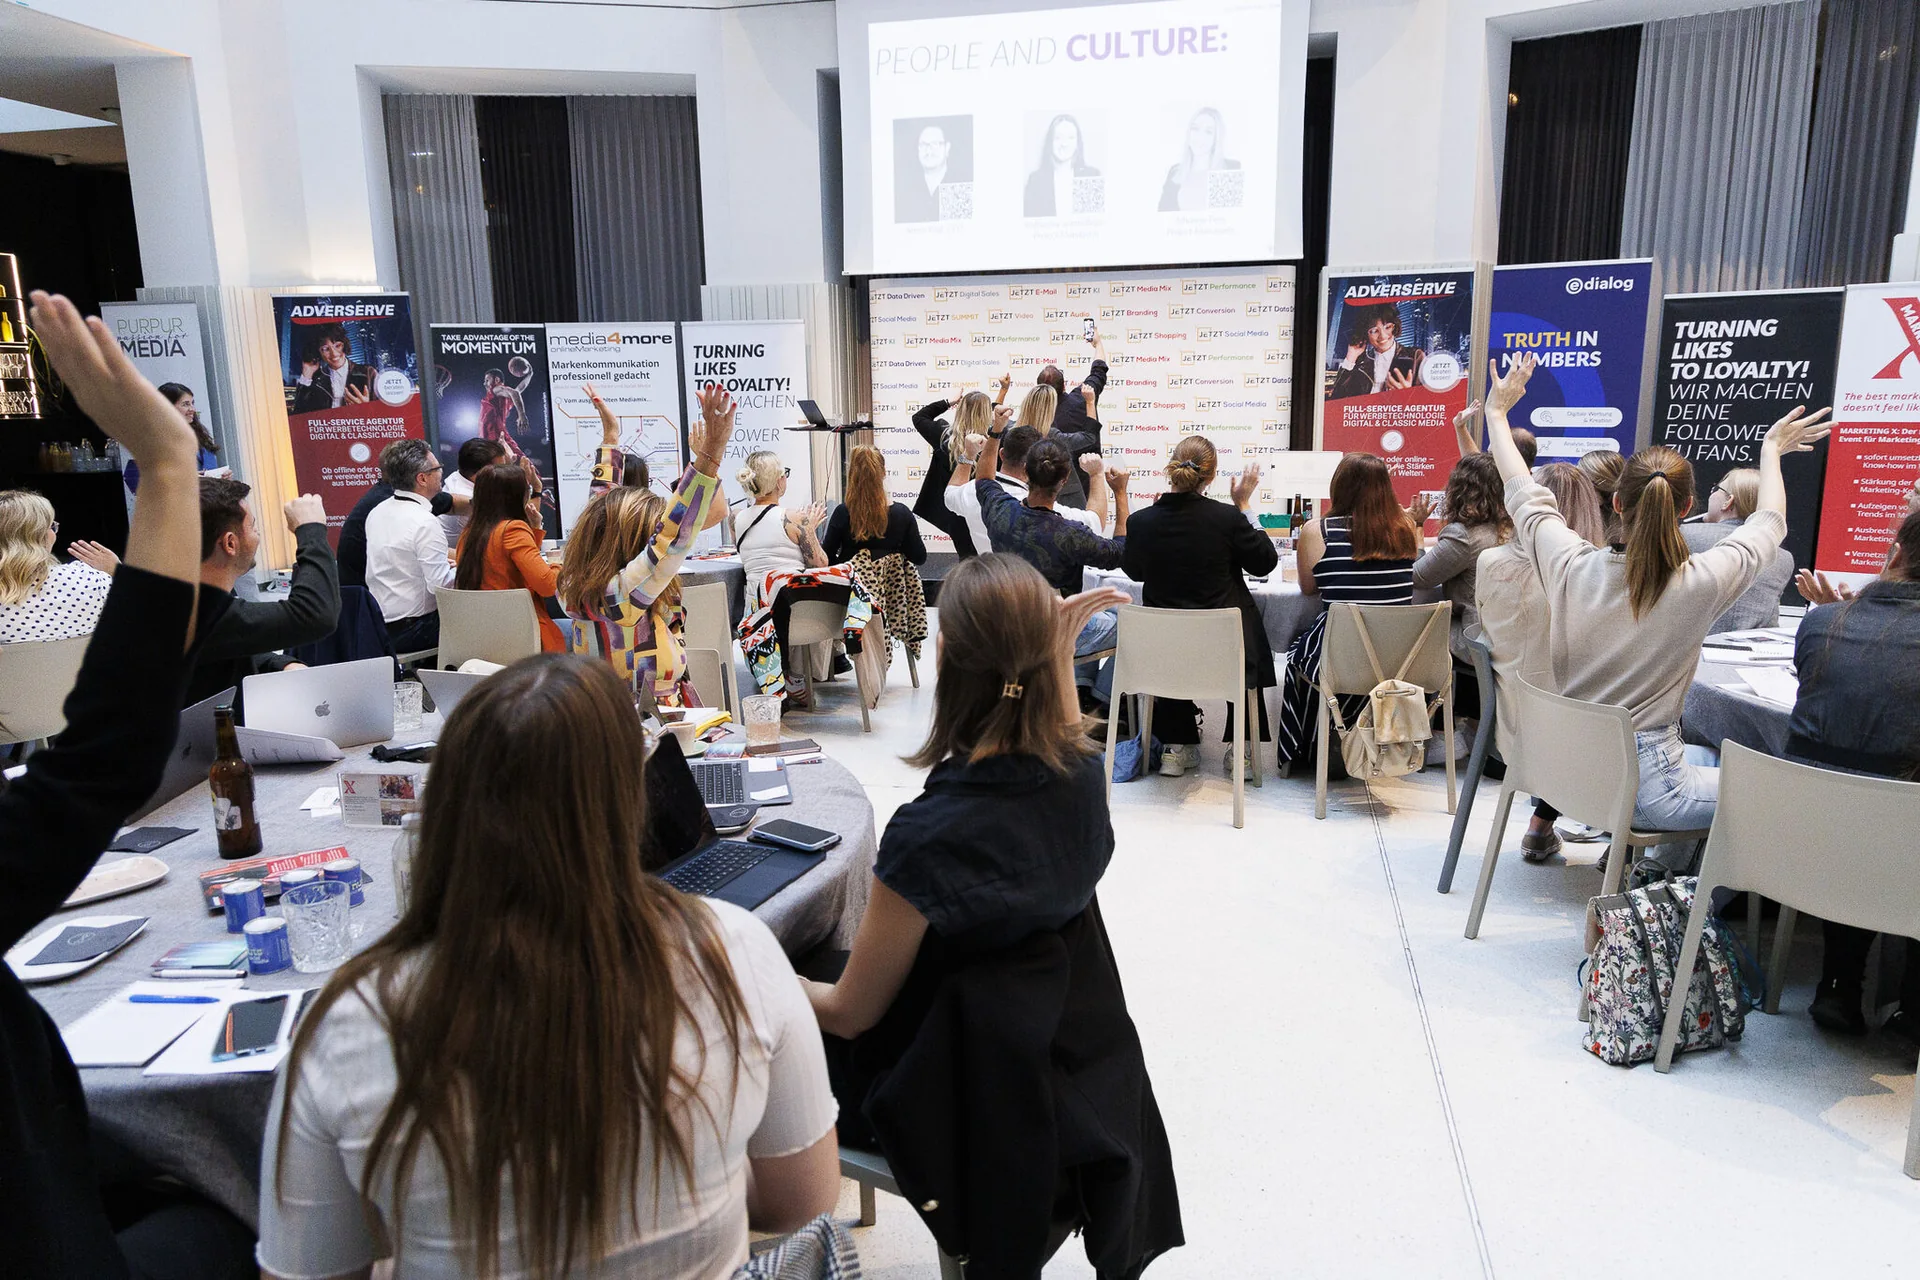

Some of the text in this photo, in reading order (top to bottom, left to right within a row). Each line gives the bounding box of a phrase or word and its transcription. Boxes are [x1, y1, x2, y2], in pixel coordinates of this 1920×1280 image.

[876, 24, 1228, 76] PEOPLE AND CULTURE:
[1344, 281, 1457, 298] ADVERSERVE
[960, 291, 980, 299] Digital
[290, 304, 396, 318] ADVERSERVE
[1126, 309, 1158, 318] Branding
[117, 317, 183, 334] PURPUR
[1674, 318, 1779, 339] TURNING
[549, 331, 673, 346] media4more
[1154, 332, 1187, 341] Shopping
[1503, 330, 1598, 348] TRUTH IN
[120, 339, 186, 358] MEDIA
[441, 341, 537, 354] MOMENTUM
[550, 345, 621, 353] onlineMarketing
[693, 343, 765, 359] TURNING
[1671, 341, 1734, 360] LIKES
[551, 359, 660, 369] Markenkommunikation
[961, 359, 981, 367] Digital
[694, 361, 737, 376] LIKES
[1670, 360, 1811, 380] TO LOYALTY!
[552, 370, 651, 382] professionell gedacht
[694, 377, 791, 392] TO LOYALTY!
[1126, 379, 1157, 387] Branding
[1669, 382, 1814, 400] WIR MACHEN
[1844, 392, 1920, 401] The best mark
[730, 394, 796, 409] MACHEN
[1343, 404, 1446, 413] FULL-SERVICE AGENTUR
[1666, 403, 1733, 420] DEINE
[1842, 403, 1920, 413] doesn't feel lik
[1359, 411, 1447, 420] WERBETECHNOLOGIE,
[307, 417, 405, 427] FULL-SERVICE AGENTUR
[1343, 419, 1445, 427] DIGITAL & CLASSIC MEDIA
[325, 424, 407, 433] WERBETECHNOLOGIE,
[1664, 424, 1770, 441] FOLLOWE
[1840, 427, 1890, 435] MARKETING
[1891, 427, 1900, 435] X:
[309, 432, 339, 440] DIGITAL
[341, 432, 346, 440] &
[347, 431, 380, 439] CLASSIC
[1863, 435, 1877, 443] für
[1696, 444, 1754, 462] FANS.
[1863, 453, 1888, 461] sofort
[1404, 455, 1427, 463] online
[333, 466, 356, 474] offline
[1406, 462, 1435, 470] Stärken
[334, 472, 364, 480] vereinen
[1398, 469, 1425, 477] Welten.
[1860, 478, 1896, 486] Stärkung
[1860, 486, 1915, 495] Marketing-Ko
[1857, 502, 1897, 511] Aufzeigen
[1856, 510, 1884, 518] Trends
[1854, 527, 1897, 535] Ausbreche
[1853, 535, 1894, 545] Marketing
[1851, 550, 1888, 558] Vernetzu
[1850, 558, 1886, 566] Marketin
